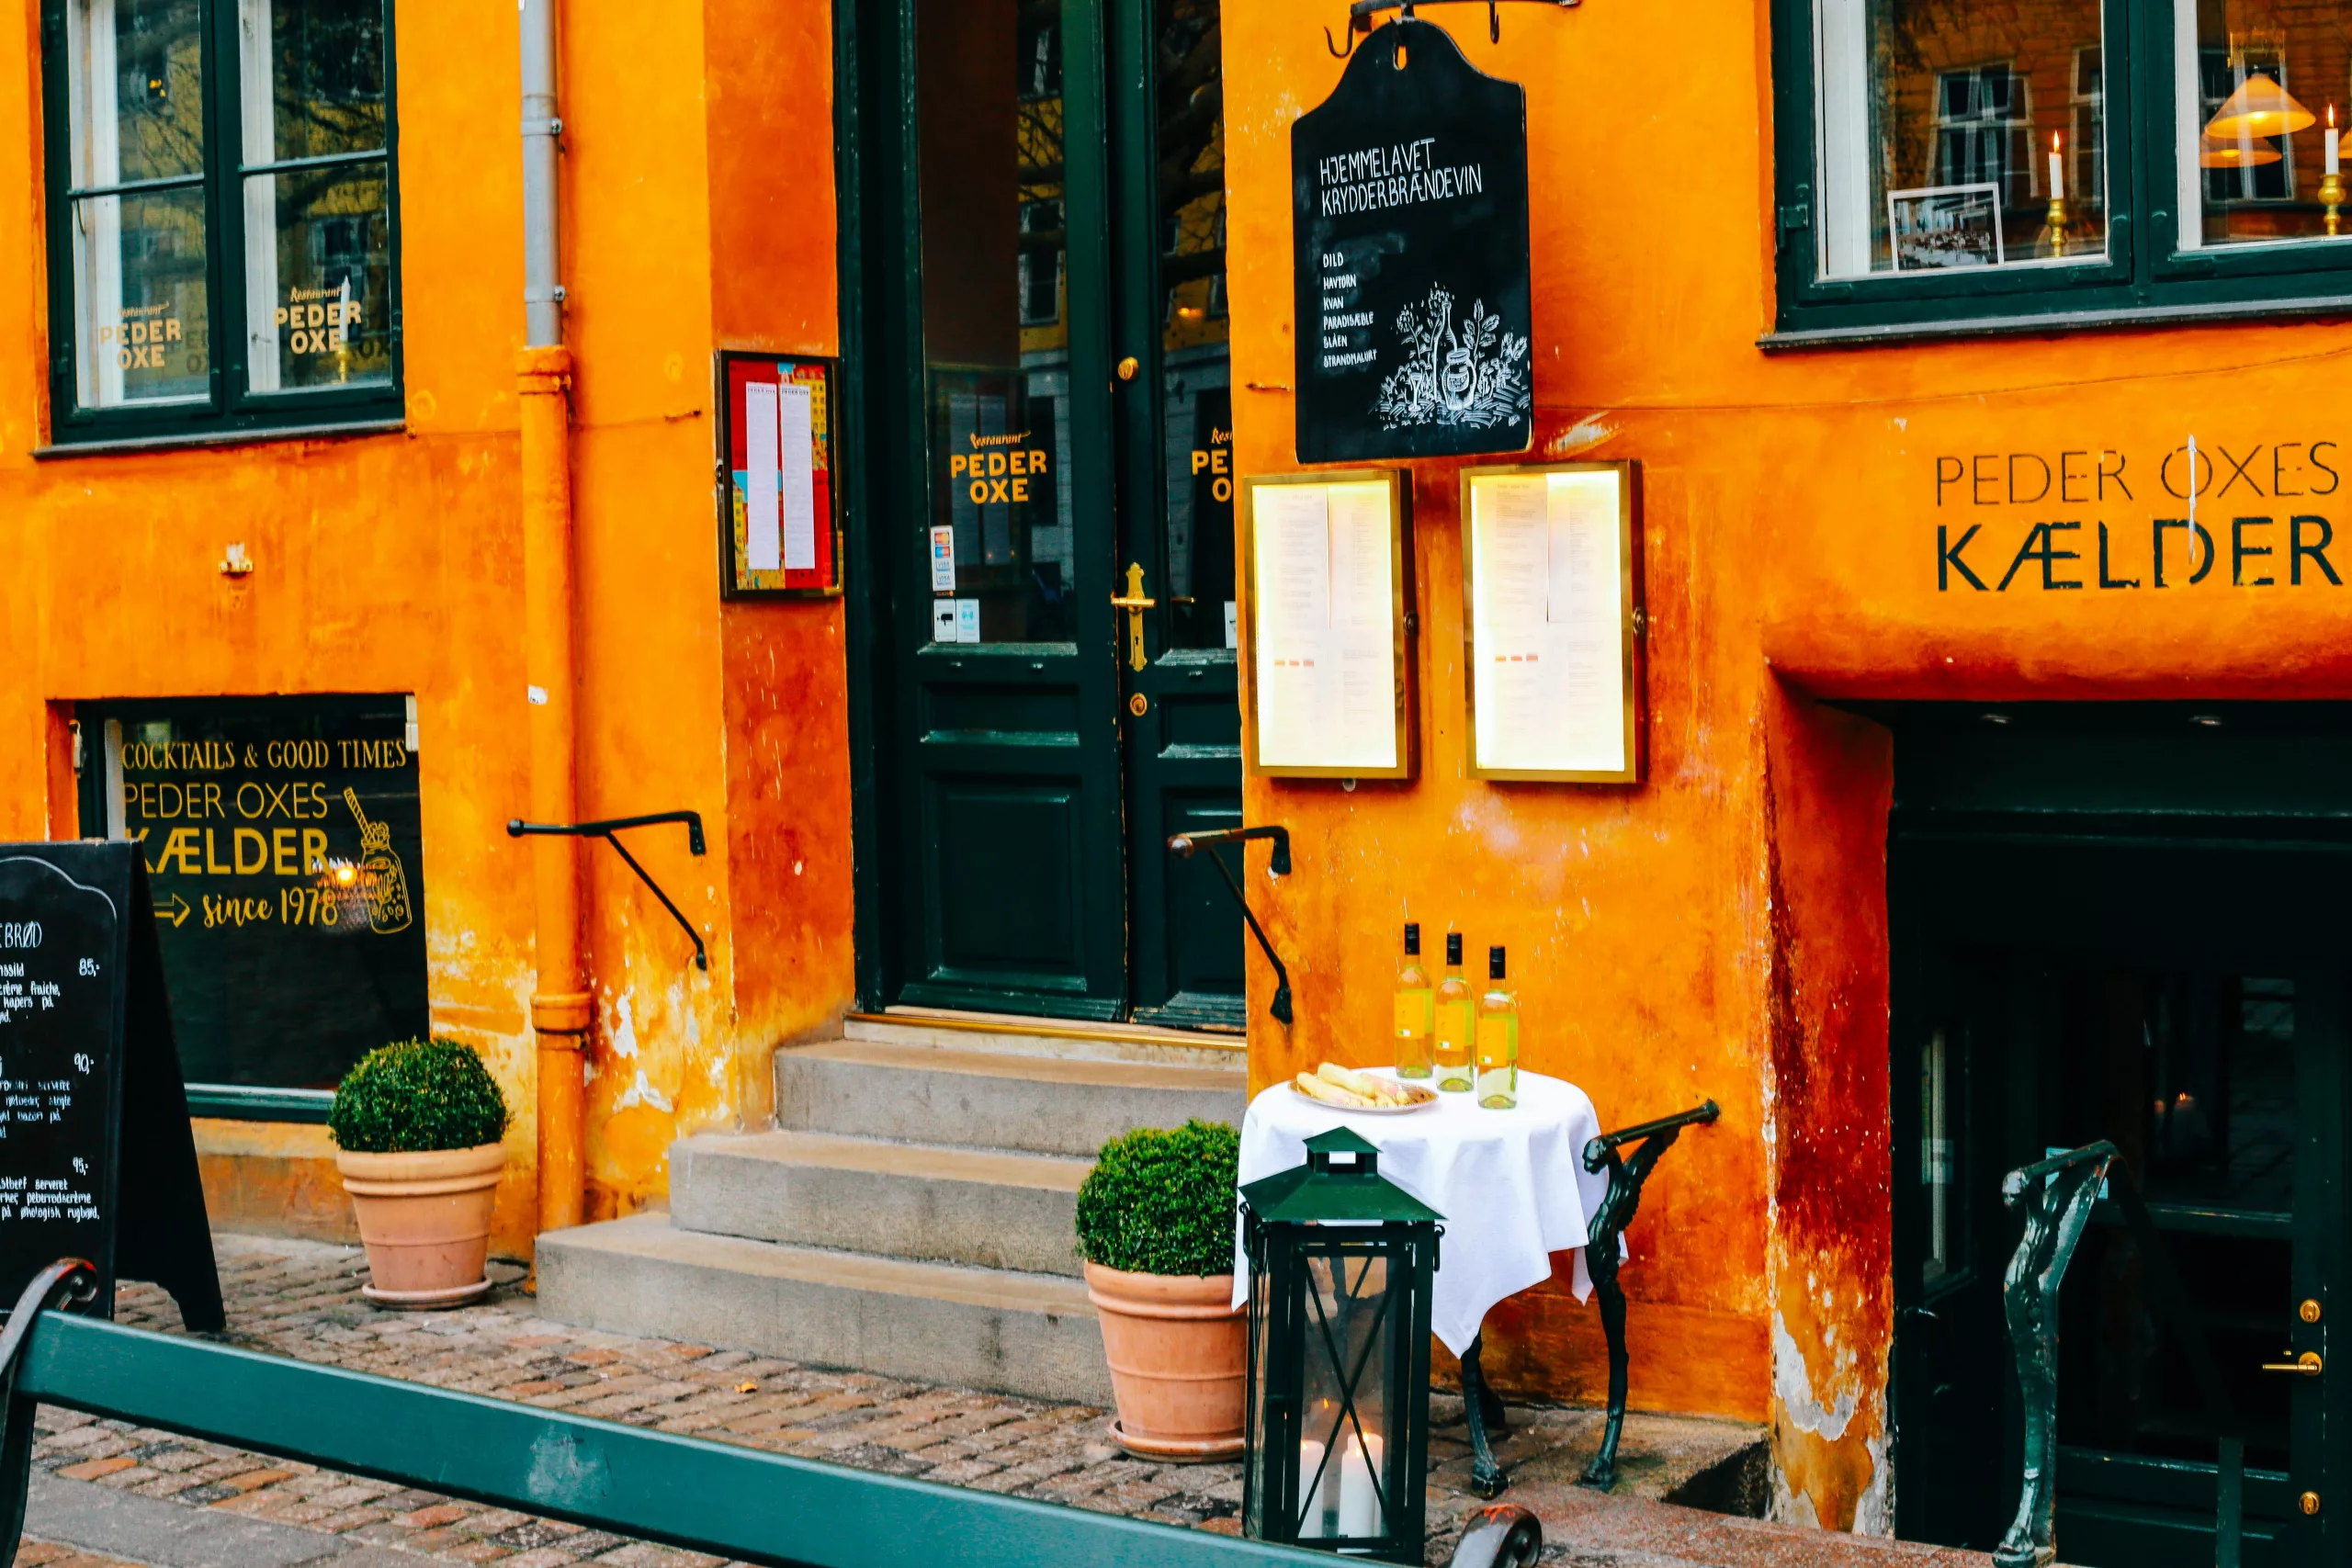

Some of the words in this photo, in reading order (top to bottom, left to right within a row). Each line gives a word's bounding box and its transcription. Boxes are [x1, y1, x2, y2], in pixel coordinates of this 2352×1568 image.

[1319, 138, 1436, 186] HJEMMELAVET
[1321, 164, 1483, 217] KRYDDERBRÆNDEVIN
[1323, 252, 1344, 268] DILD
[1323, 274, 1357, 290] HAVTORN
[273, 300, 362, 329] PEDER
[1323, 296, 1344, 311] KVAN
[100, 318, 182, 345] PEDER
[1323, 311, 1374, 331] PARADISÆBLE
[290, 326, 342, 355] OXE
[1323, 333, 1348, 349] BLÅEN
[117, 344, 165, 370] OXE
[1323, 349, 1378, 368] STRANDMALURT
[970, 430, 1031, 449] Restaurant
[950, 449, 1046, 479] PEDER
[1936, 450, 2133, 507] PEDER
[2160, 441, 2339, 500] OXES
[969, 478, 1029, 504] OXE
[1937, 514, 2344, 593] KÆLDER
[122, 739, 236, 771] COCKTAILS
[243, 743, 259, 769] &
[267, 739, 330, 769] GOOD
[337, 738, 408, 770] TIMES
[124, 782, 225, 819] PEDER
[236, 781, 328, 819] OXES
[202, 894, 273, 929] since
[280, 886, 338, 927] 1978
[0, 920, 42, 948] BRØD
